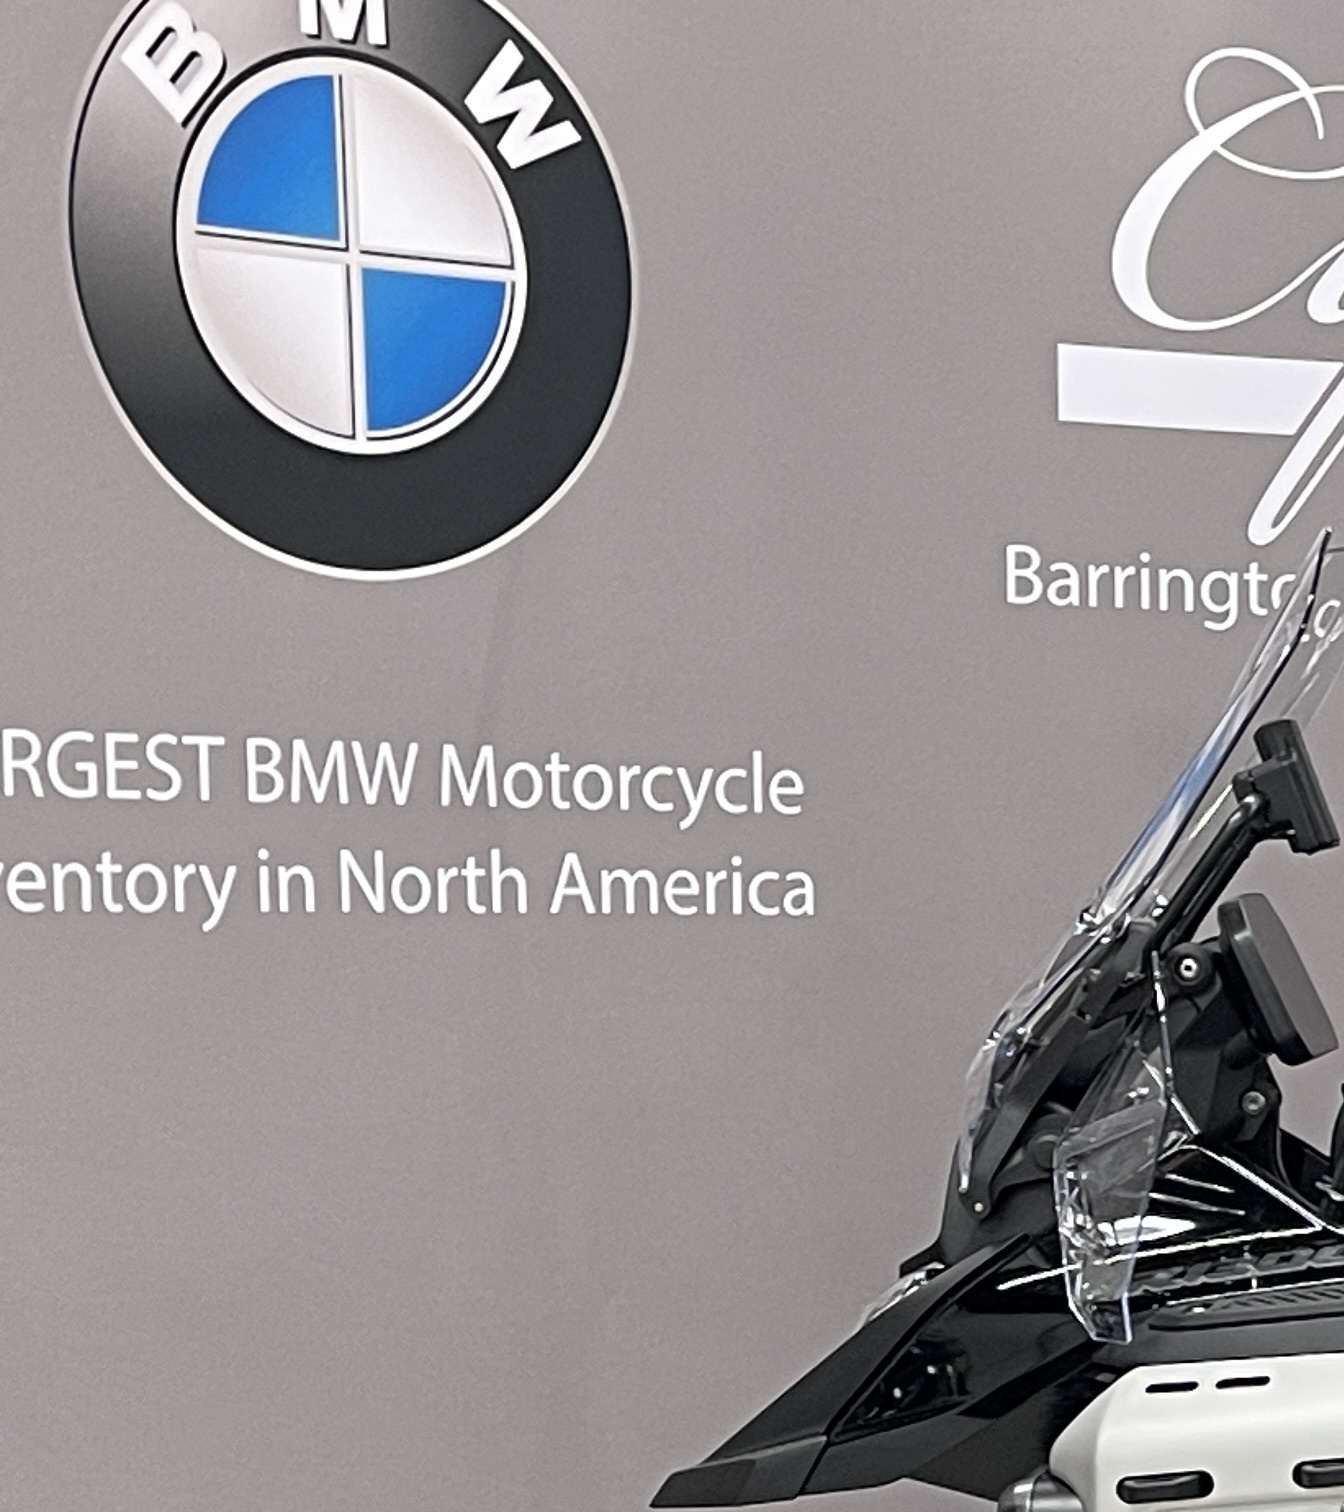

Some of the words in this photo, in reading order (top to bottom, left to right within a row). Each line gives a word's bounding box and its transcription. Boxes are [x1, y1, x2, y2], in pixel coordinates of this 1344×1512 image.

[0, 727, 227, 802] RGEST
[245, 736, 420, 807] BMW
[440, 742, 805, 831] Motorcycle
[0, 850, 238, 933] entory
[257, 847, 316, 914] in
[338, 847, 529, 915] North
[548, 851, 815, 917] America
